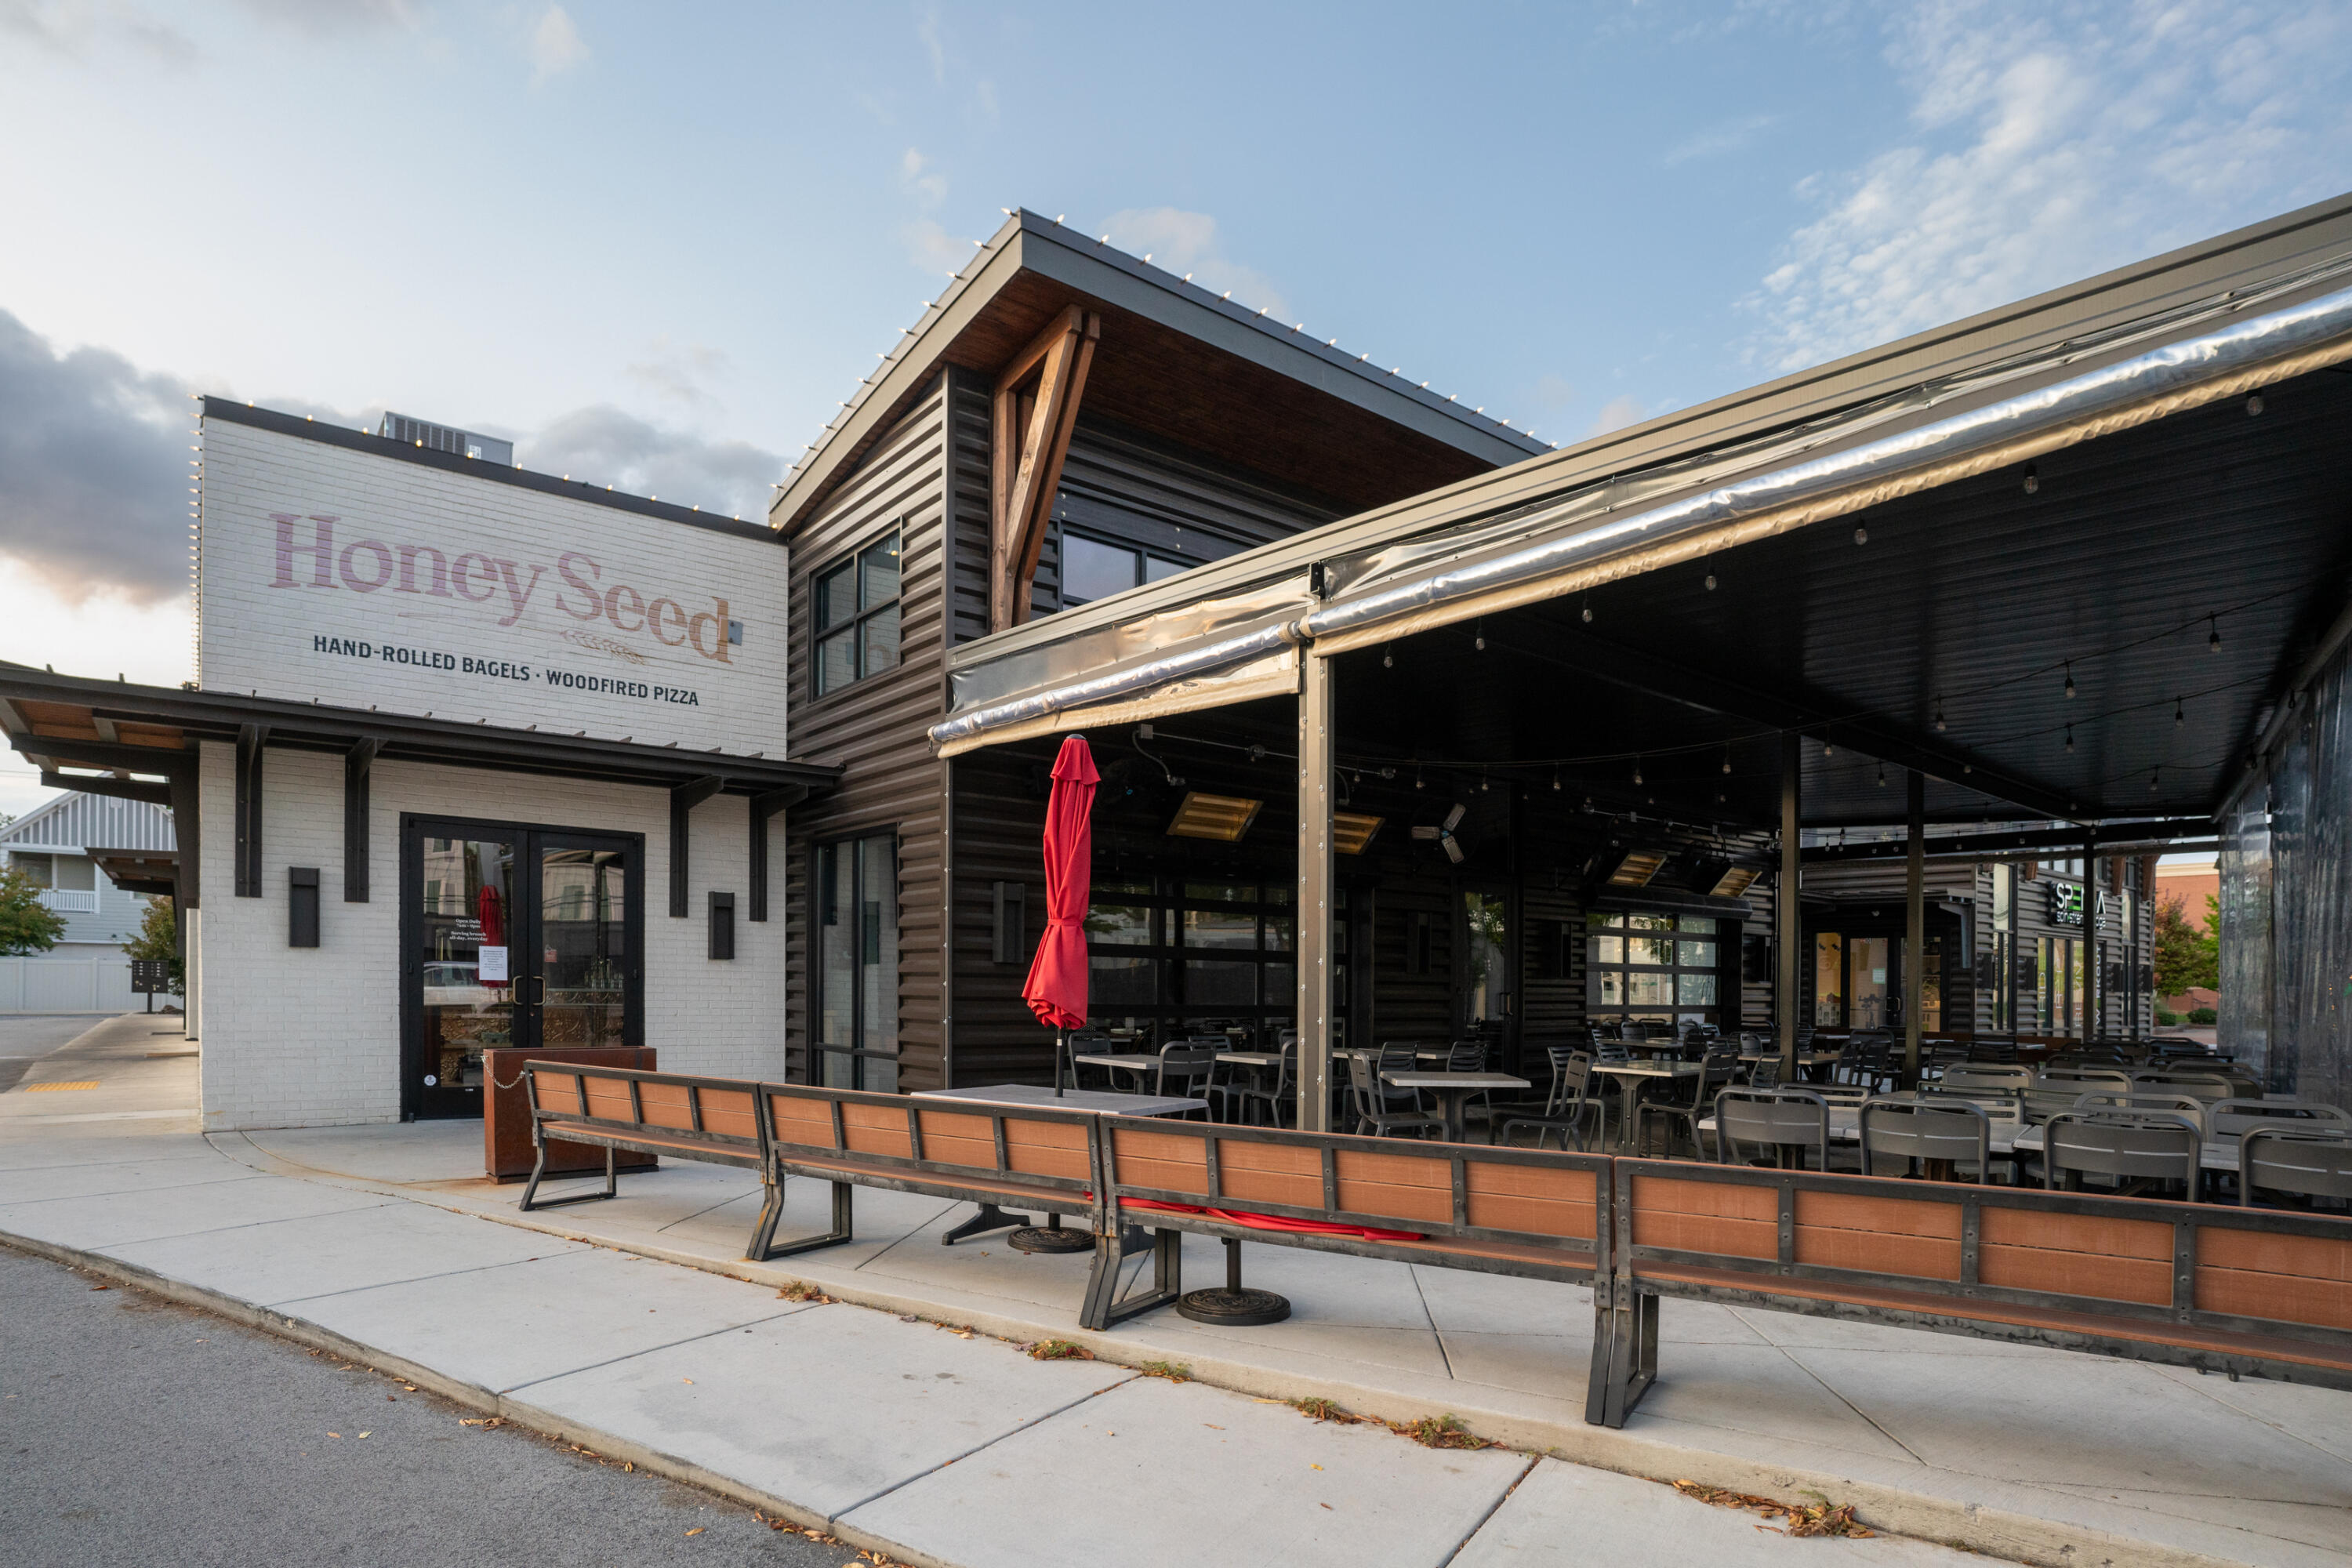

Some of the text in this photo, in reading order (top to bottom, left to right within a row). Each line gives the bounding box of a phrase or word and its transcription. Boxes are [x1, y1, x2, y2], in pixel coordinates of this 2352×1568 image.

[267, 513, 733, 665] Honey Seed
[314, 635, 456, 670] HAND-ROLLED
[462, 657, 531, 681] BAGELS
[546, 669, 648, 699] WOODFIRED
[653, 686, 699, 706] PIZZA
[2056, 883, 2107, 916] SPEA
